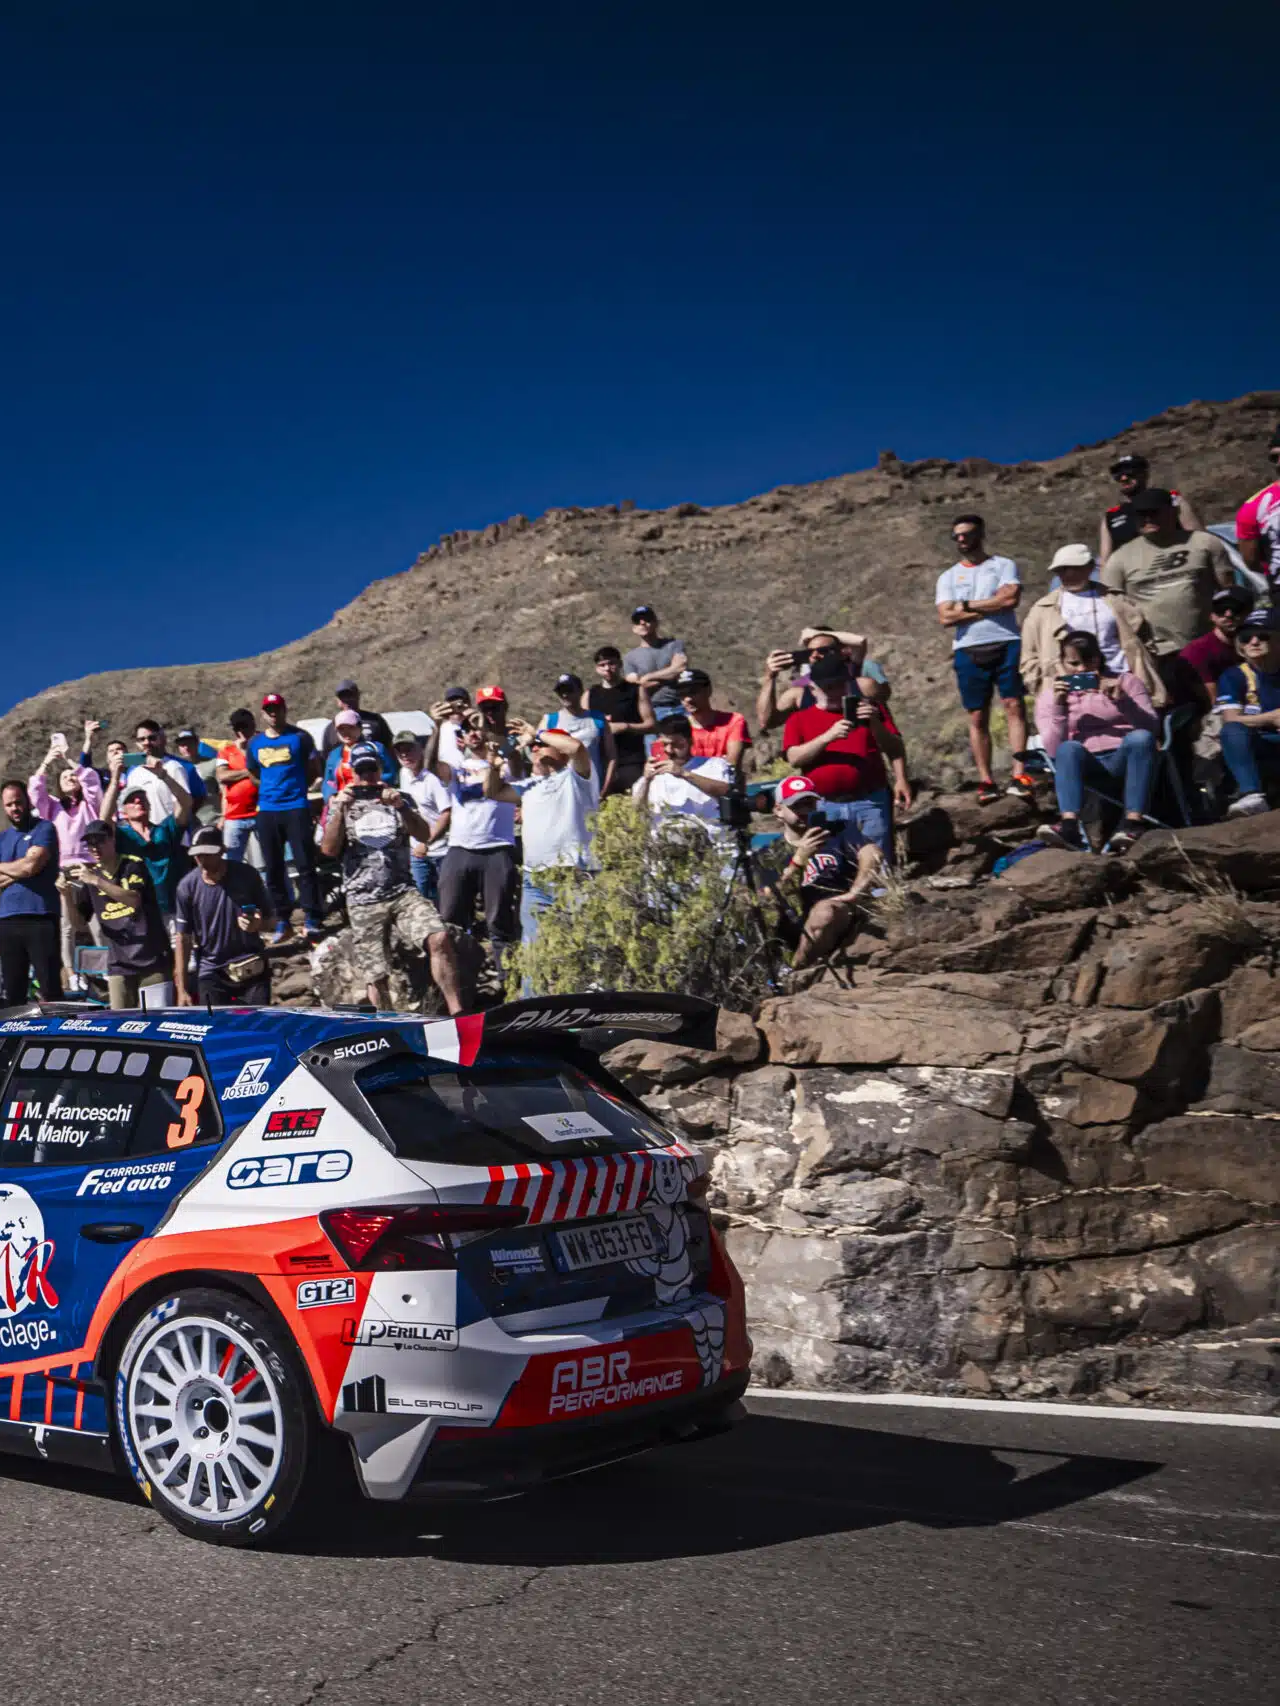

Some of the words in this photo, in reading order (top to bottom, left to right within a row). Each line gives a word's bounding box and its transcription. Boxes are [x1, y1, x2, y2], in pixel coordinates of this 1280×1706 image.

[499, 1008, 590, 1032] AMD
[585, 1013, 681, 1022] MOTORSPORT
[334, 1037, 390, 1059] SKODA
[223, 1084, 268, 1098] JOSENIO
[24, 1102, 42, 1118] M.
[46, 1103, 132, 1121] Franceschi
[167, 1075, 205, 1148] 3
[267, 1111, 324, 1131] ETS
[17, 1125, 33, 1141] A.
[37, 1125, 89, 1147] Malfoy
[105, 1161, 176, 1178] CARROSSERIE
[76, 1169, 127, 1196] Fred
[126, 1175, 171, 1192] auto
[562, 1221, 652, 1265] WW-853-FG
[299, 1279, 354, 1303] GT2i
[552, 1351, 631, 1394] ABR
[549, 1370, 683, 1415] PERFORMANCE
